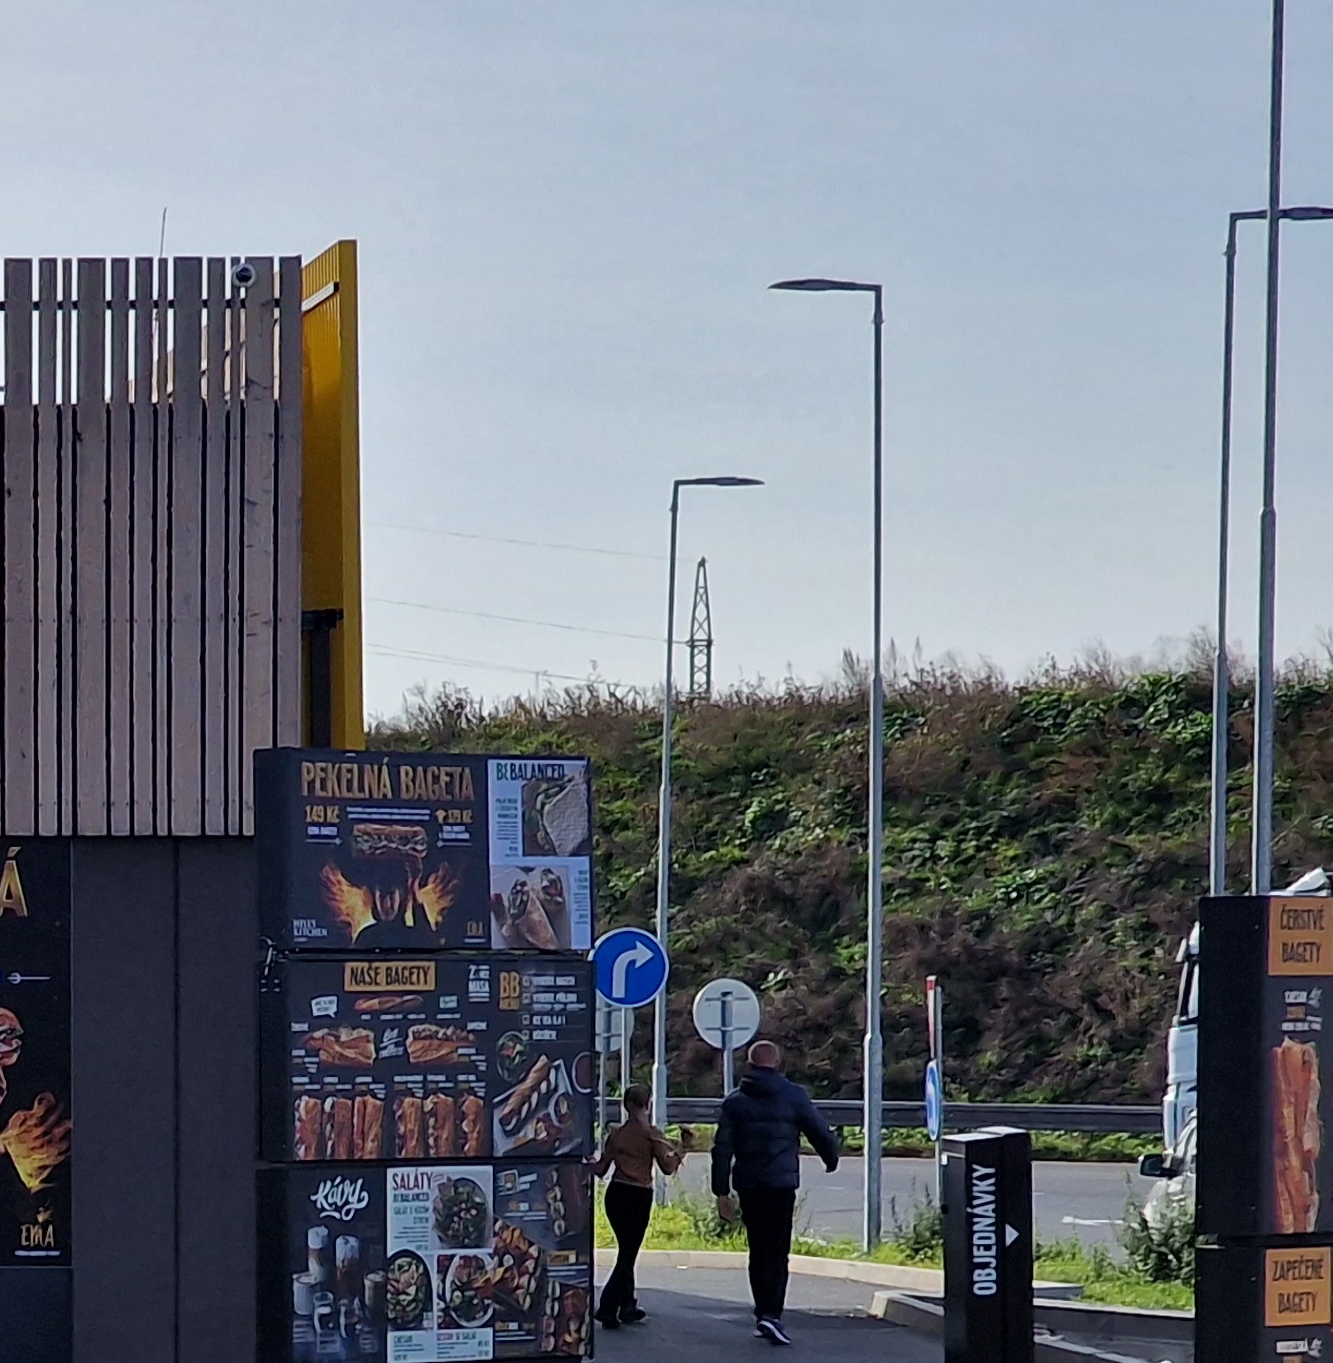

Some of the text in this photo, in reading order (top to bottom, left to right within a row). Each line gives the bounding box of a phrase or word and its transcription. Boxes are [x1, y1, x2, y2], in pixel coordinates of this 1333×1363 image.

[301, 757, 475, 801] PEKELNÁ BAGETA
[1281, 941, 1322, 963] BAGETY
[350, 964, 430, 986] NAŠE BAGETY
[392, 1168, 433, 1191] SALÁTY
[310, 1175, 369, 1221] Kávy
[966, 1164, 997, 1296] OBJEDNÁVKY
[1277, 1291, 1319, 1314] BAGETY
